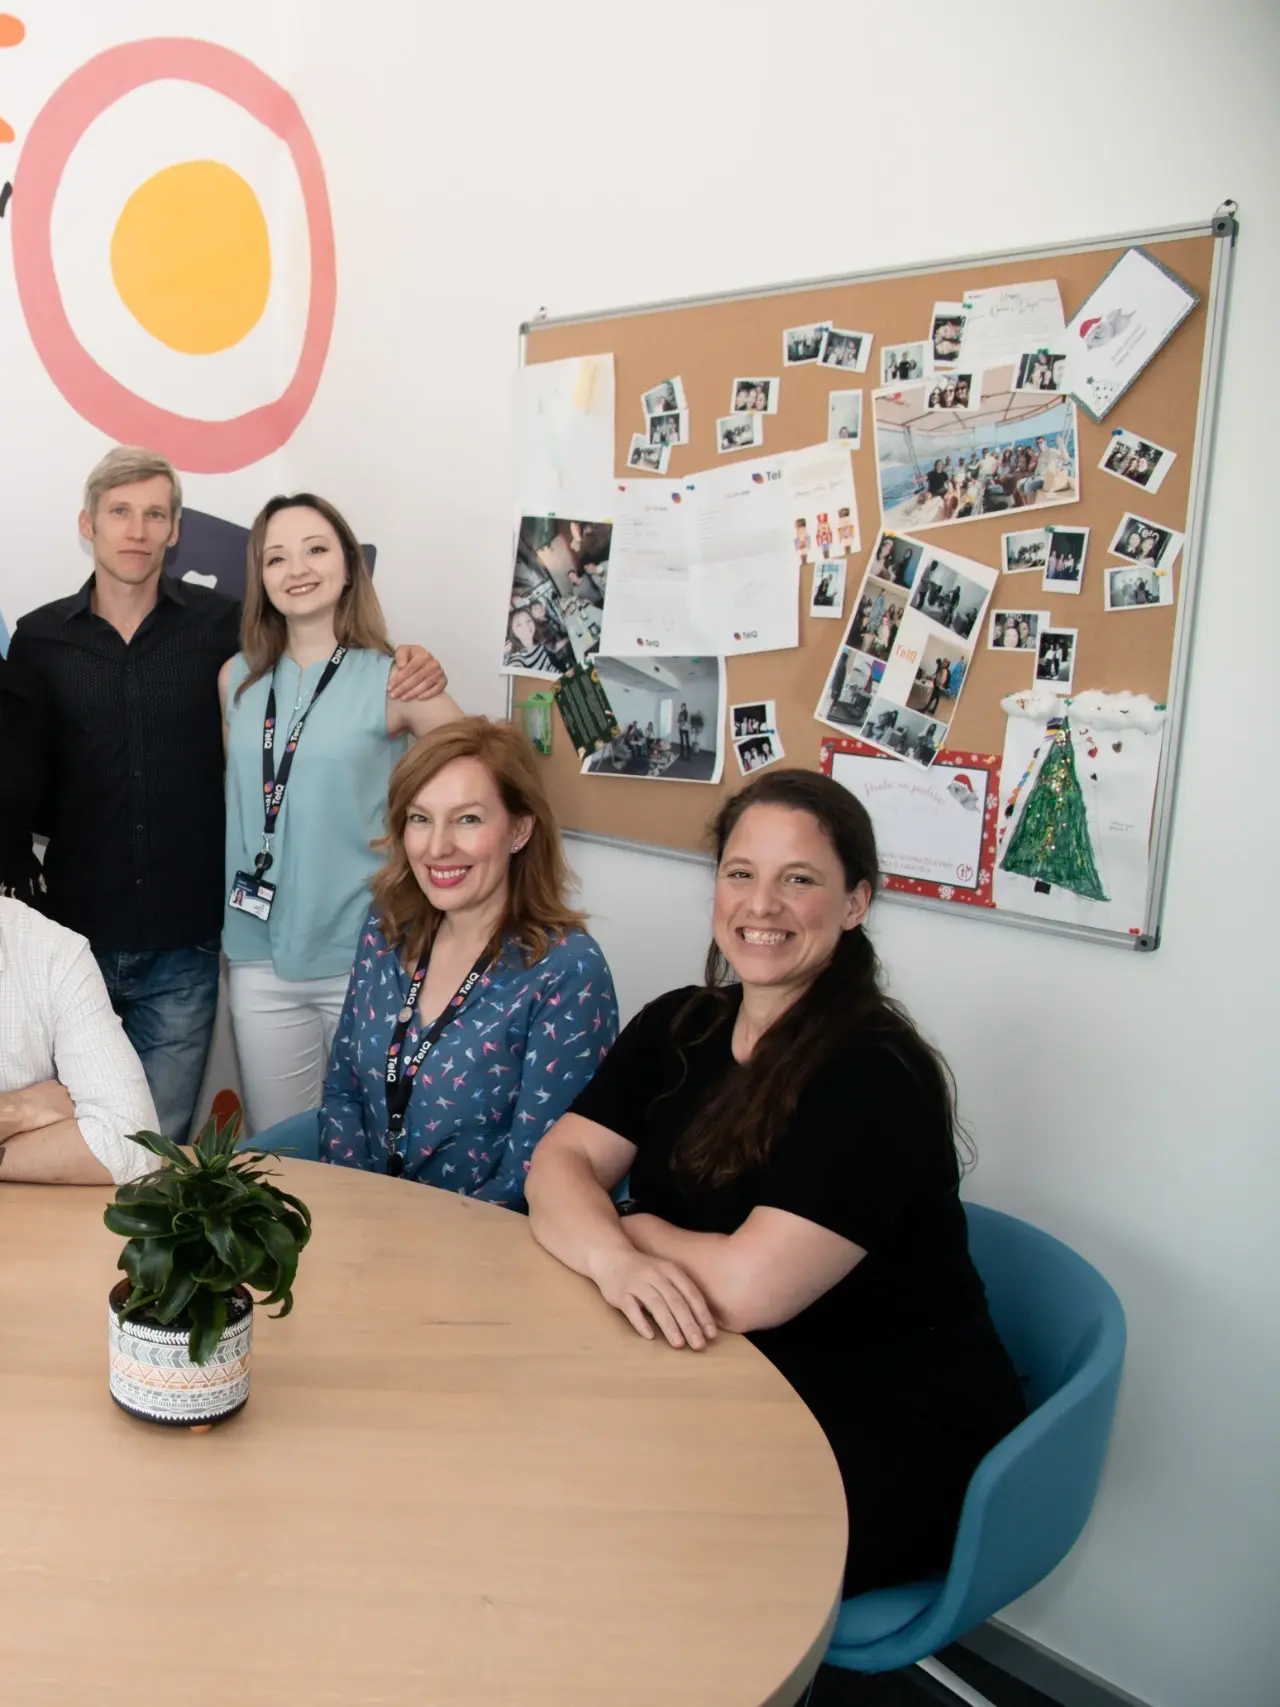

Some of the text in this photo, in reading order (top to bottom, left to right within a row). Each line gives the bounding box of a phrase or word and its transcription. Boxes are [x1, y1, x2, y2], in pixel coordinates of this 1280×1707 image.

[766, 469, 782, 481] Tel
[331, 646, 347, 665] TelQ
[264, 728, 273, 749] TelQ
[272, 784, 285, 805] TelQ
[406, 982, 421, 1005] TelQ
[459, 972, 480, 995] TelQ
[412, 1040, 432, 1064] TelQ
[387, 1057, 397, 1082] TelQ
